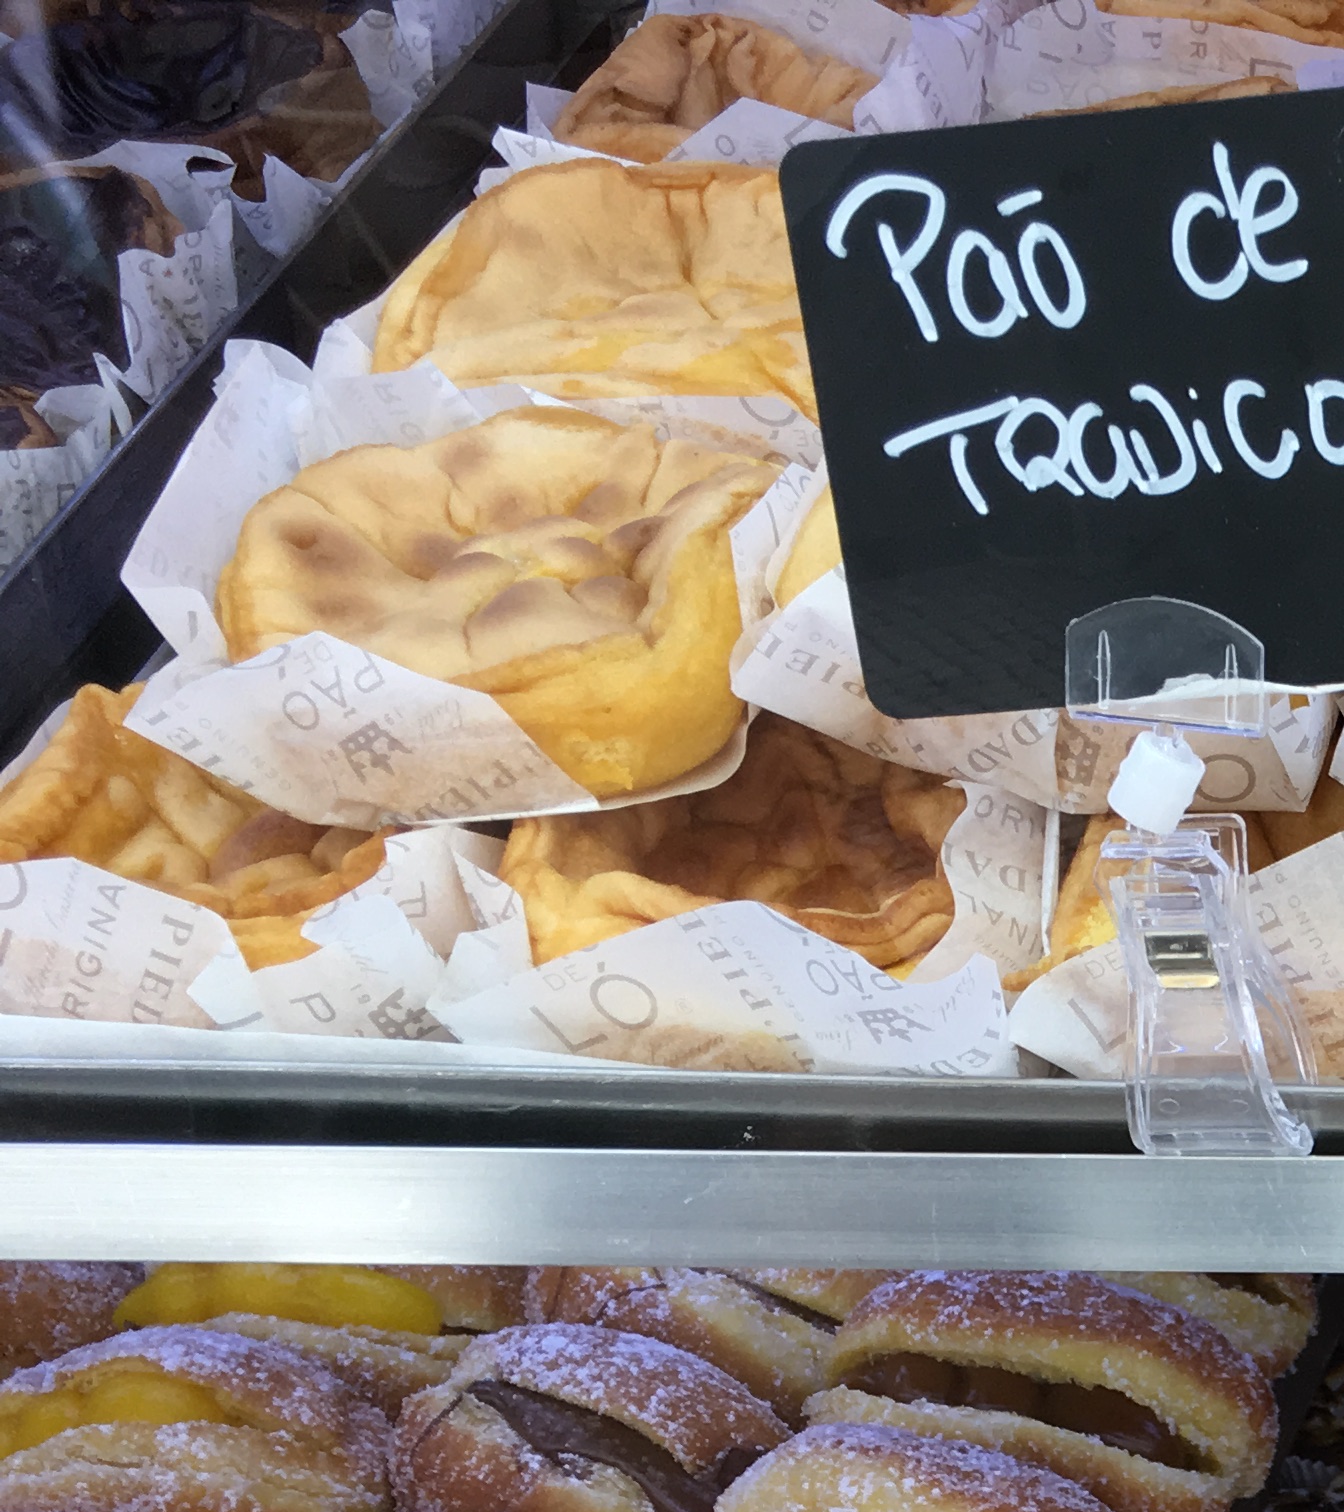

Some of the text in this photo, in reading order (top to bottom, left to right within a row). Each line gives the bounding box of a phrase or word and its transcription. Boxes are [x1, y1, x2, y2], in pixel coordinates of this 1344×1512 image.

[827, 173, 1087, 343] Pão
[1172, 140, 1308, 301] de
[529, 960, 659, 1054] LÓ
